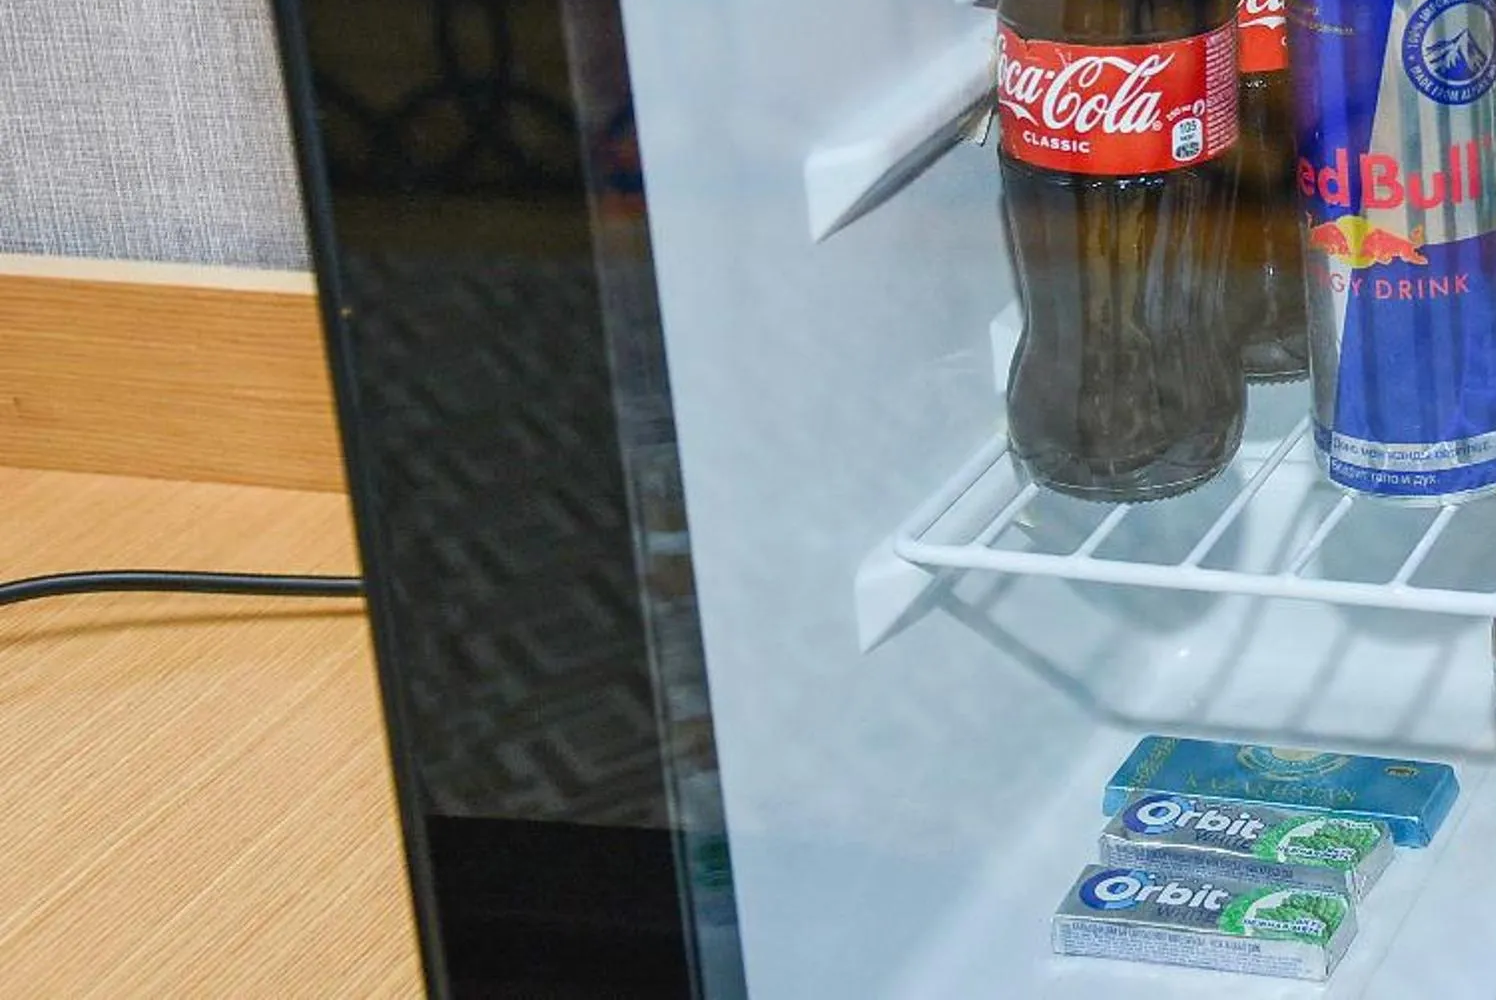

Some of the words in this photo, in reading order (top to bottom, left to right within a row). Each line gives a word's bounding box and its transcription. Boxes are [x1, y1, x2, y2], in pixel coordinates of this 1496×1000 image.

[998, 34, 1175, 134] oca-Cola
[1023, 130, 1091, 154] CLASSIC
[1359, 139, 1481, 210] Bull
[1374, 272, 1470, 300] DRINK
[1136, 800, 1265, 840] Orbit
[1094, 876, 1230, 910] Orbit
